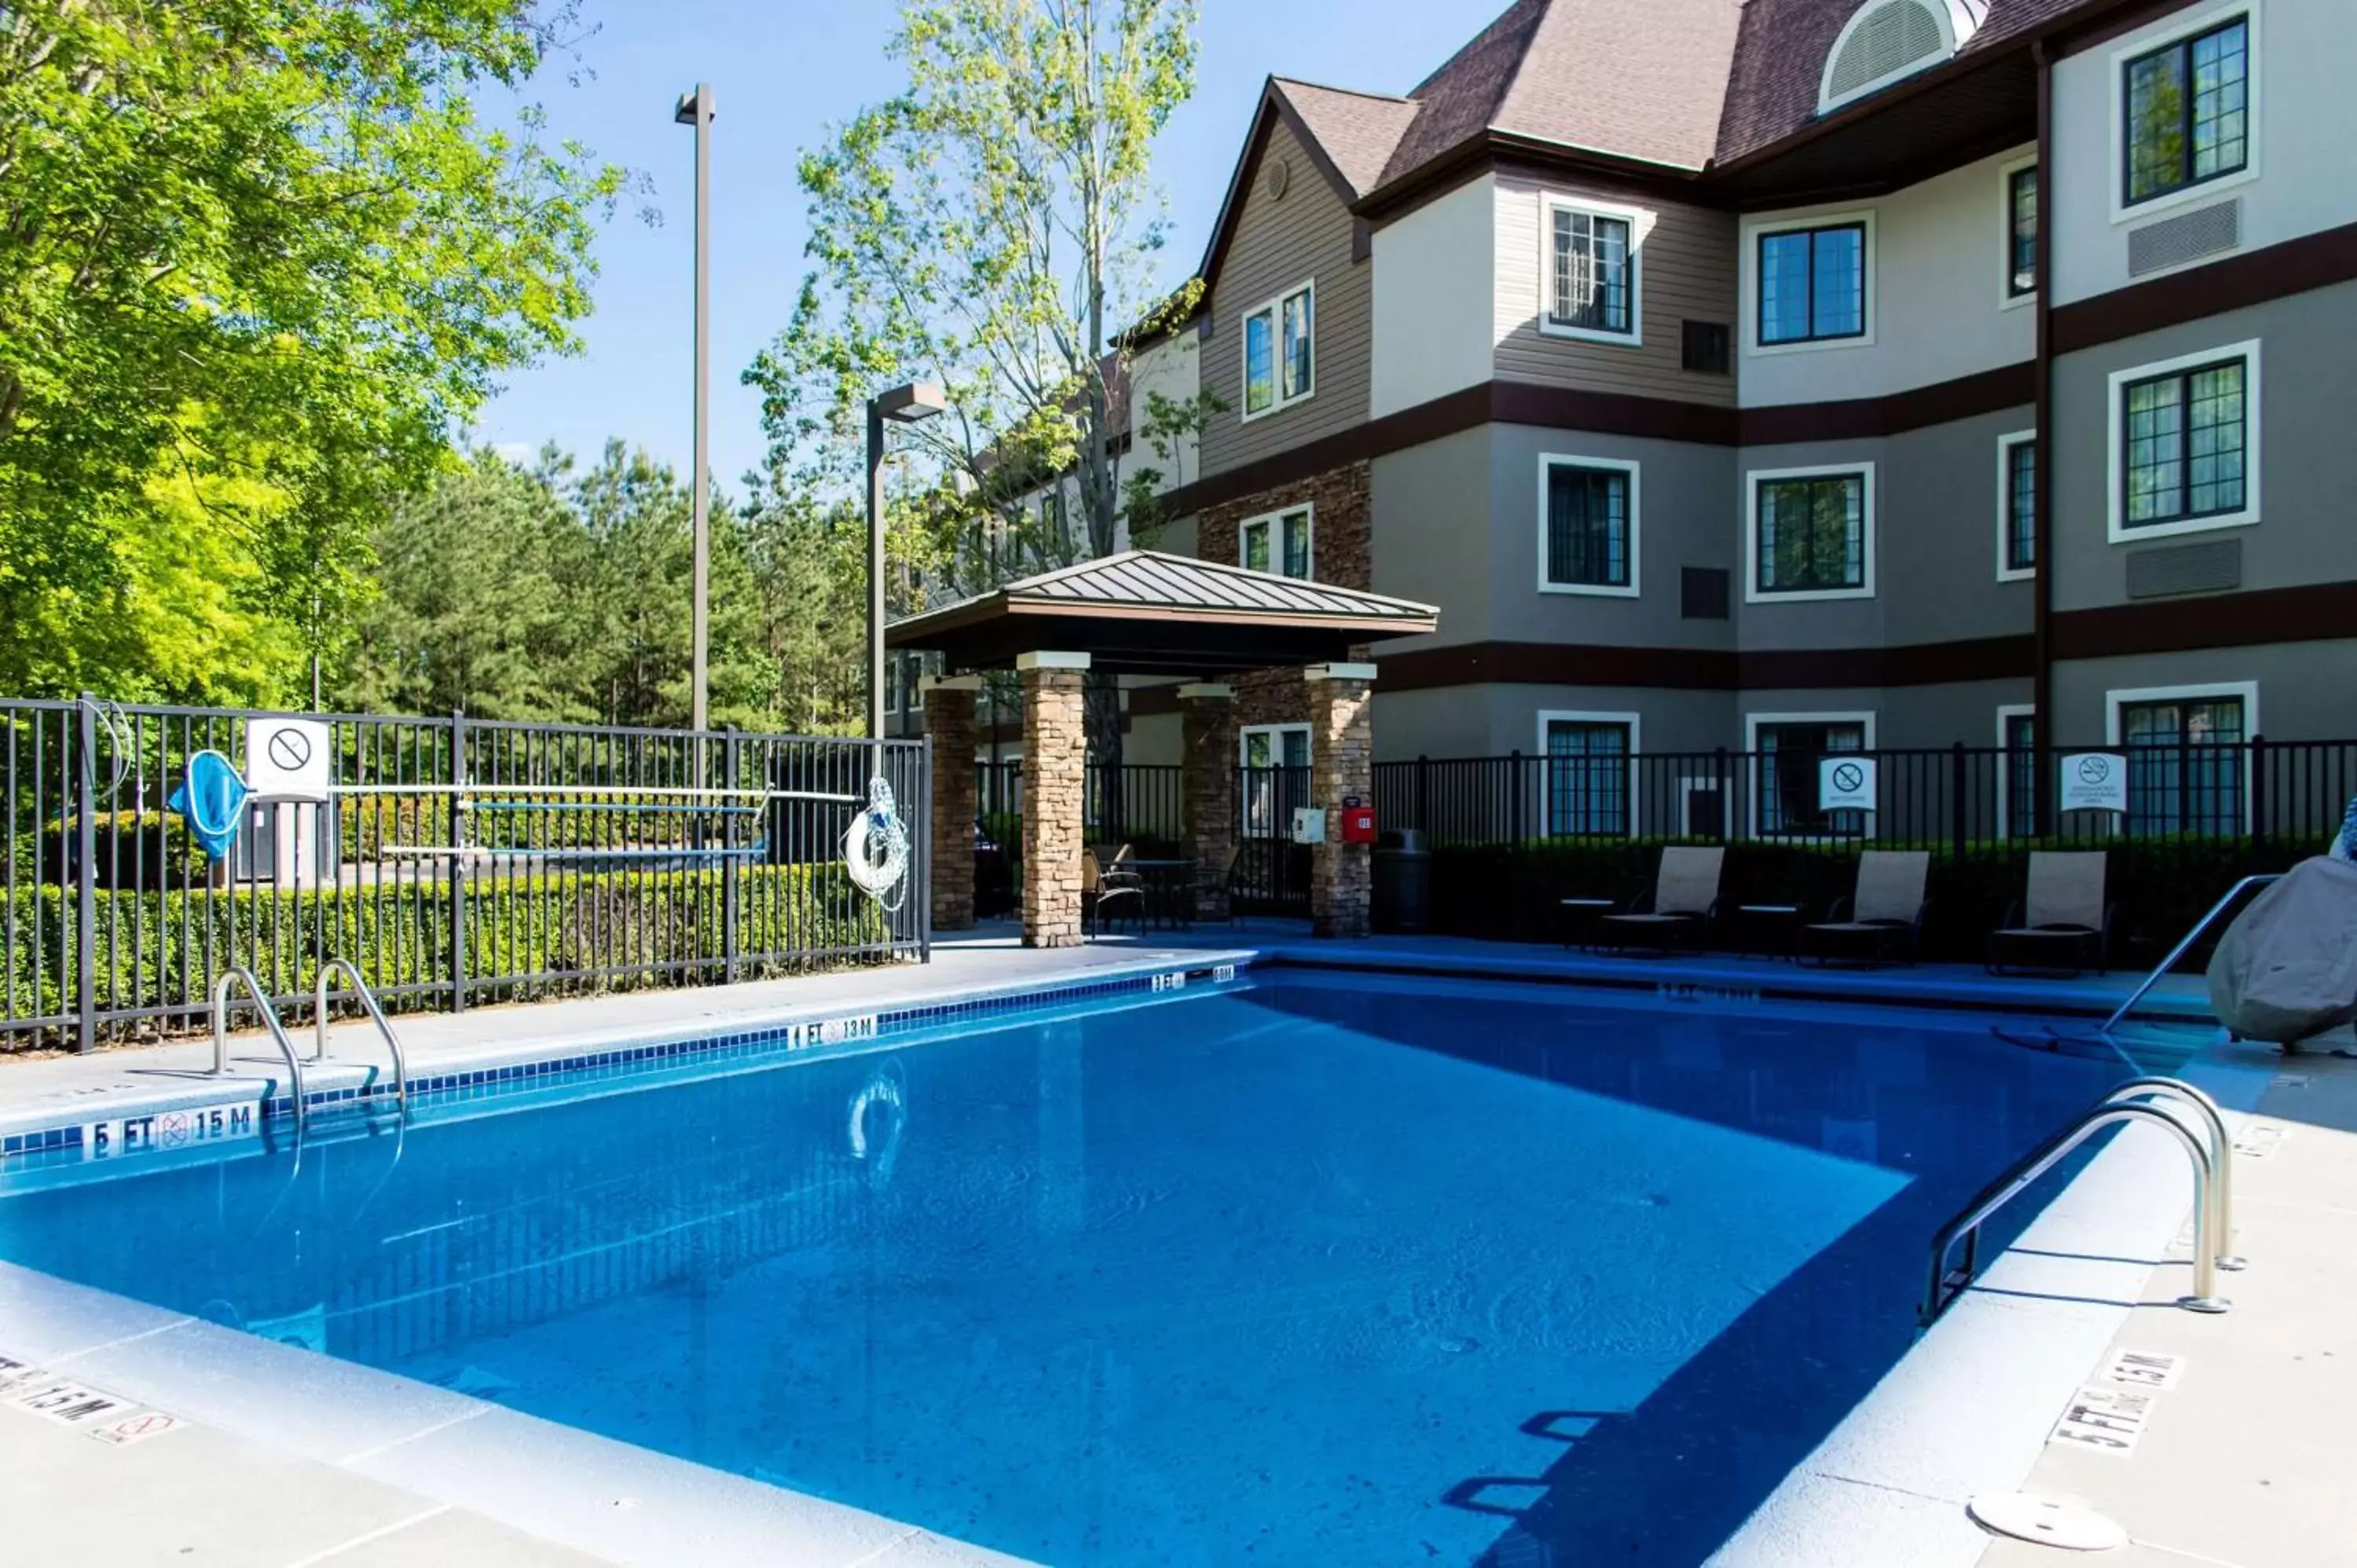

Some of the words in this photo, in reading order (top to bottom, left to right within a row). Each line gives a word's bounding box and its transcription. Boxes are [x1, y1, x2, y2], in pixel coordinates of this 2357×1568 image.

[94, 1123, 109, 1153] 5
[123, 1116, 154, 1149] FT
[2066, 1405, 2140, 1434] FT
[2056, 1428, 2130, 1449] 5
